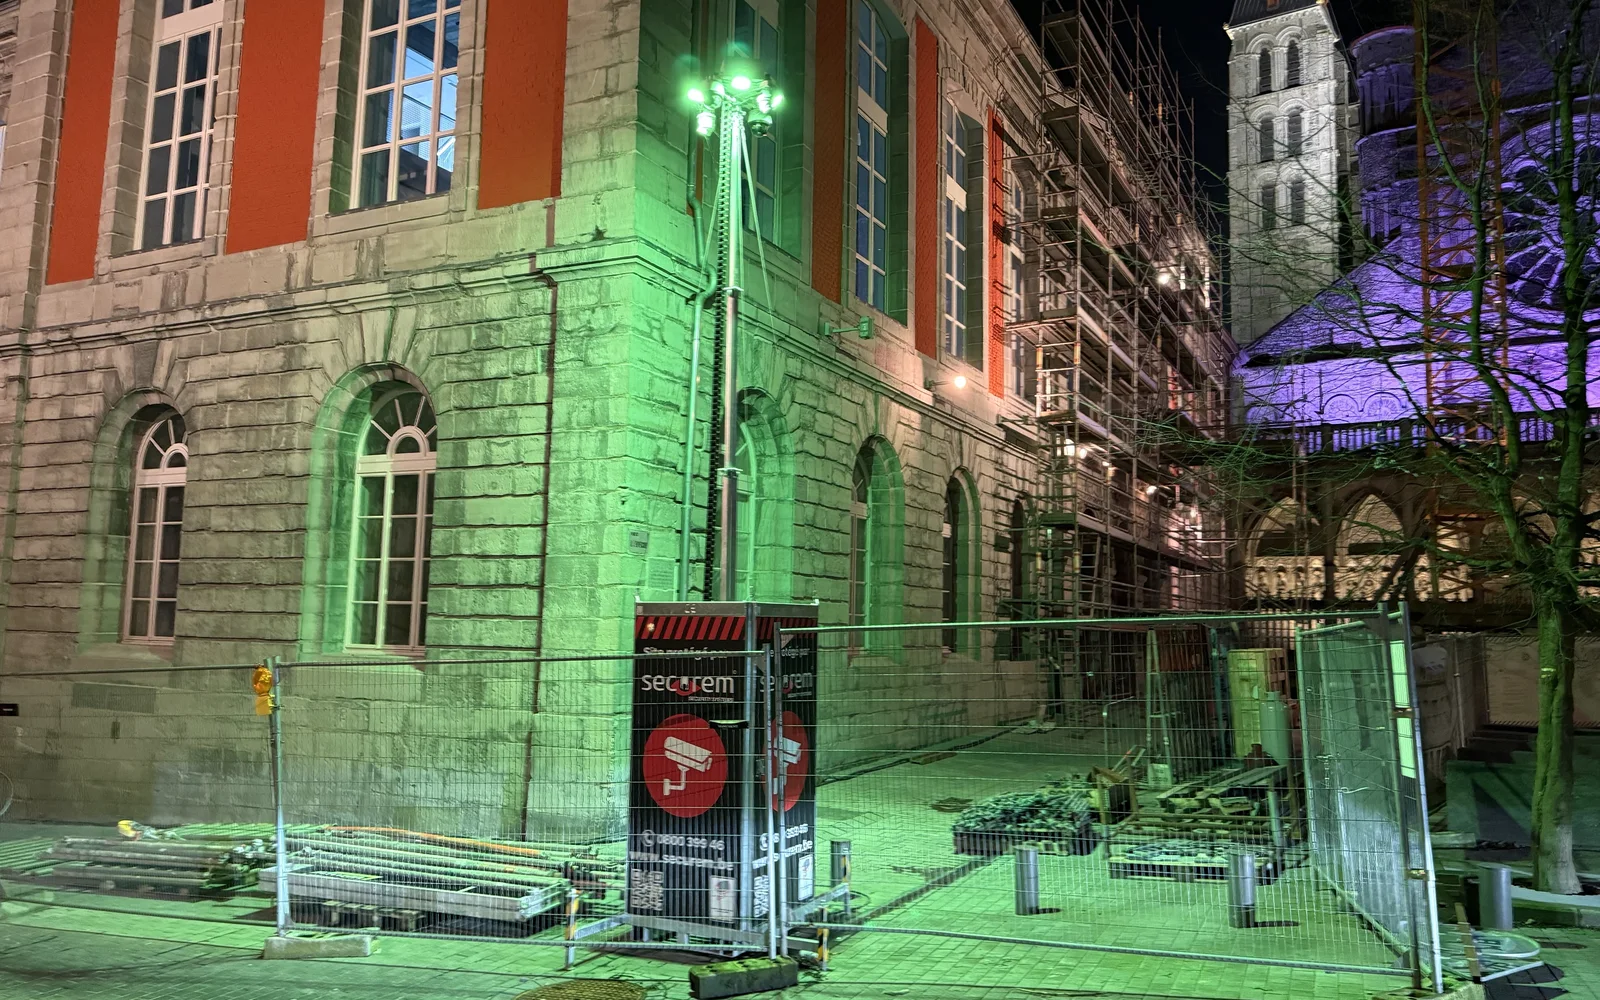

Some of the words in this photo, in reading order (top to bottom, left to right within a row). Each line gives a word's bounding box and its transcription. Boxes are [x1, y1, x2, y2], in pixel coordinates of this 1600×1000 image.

[641, 674, 734, 694] securem
[657, 834, 685, 847] 0800
[686, 836, 708, 849] 399
[708, 839, 725, 851] 46
